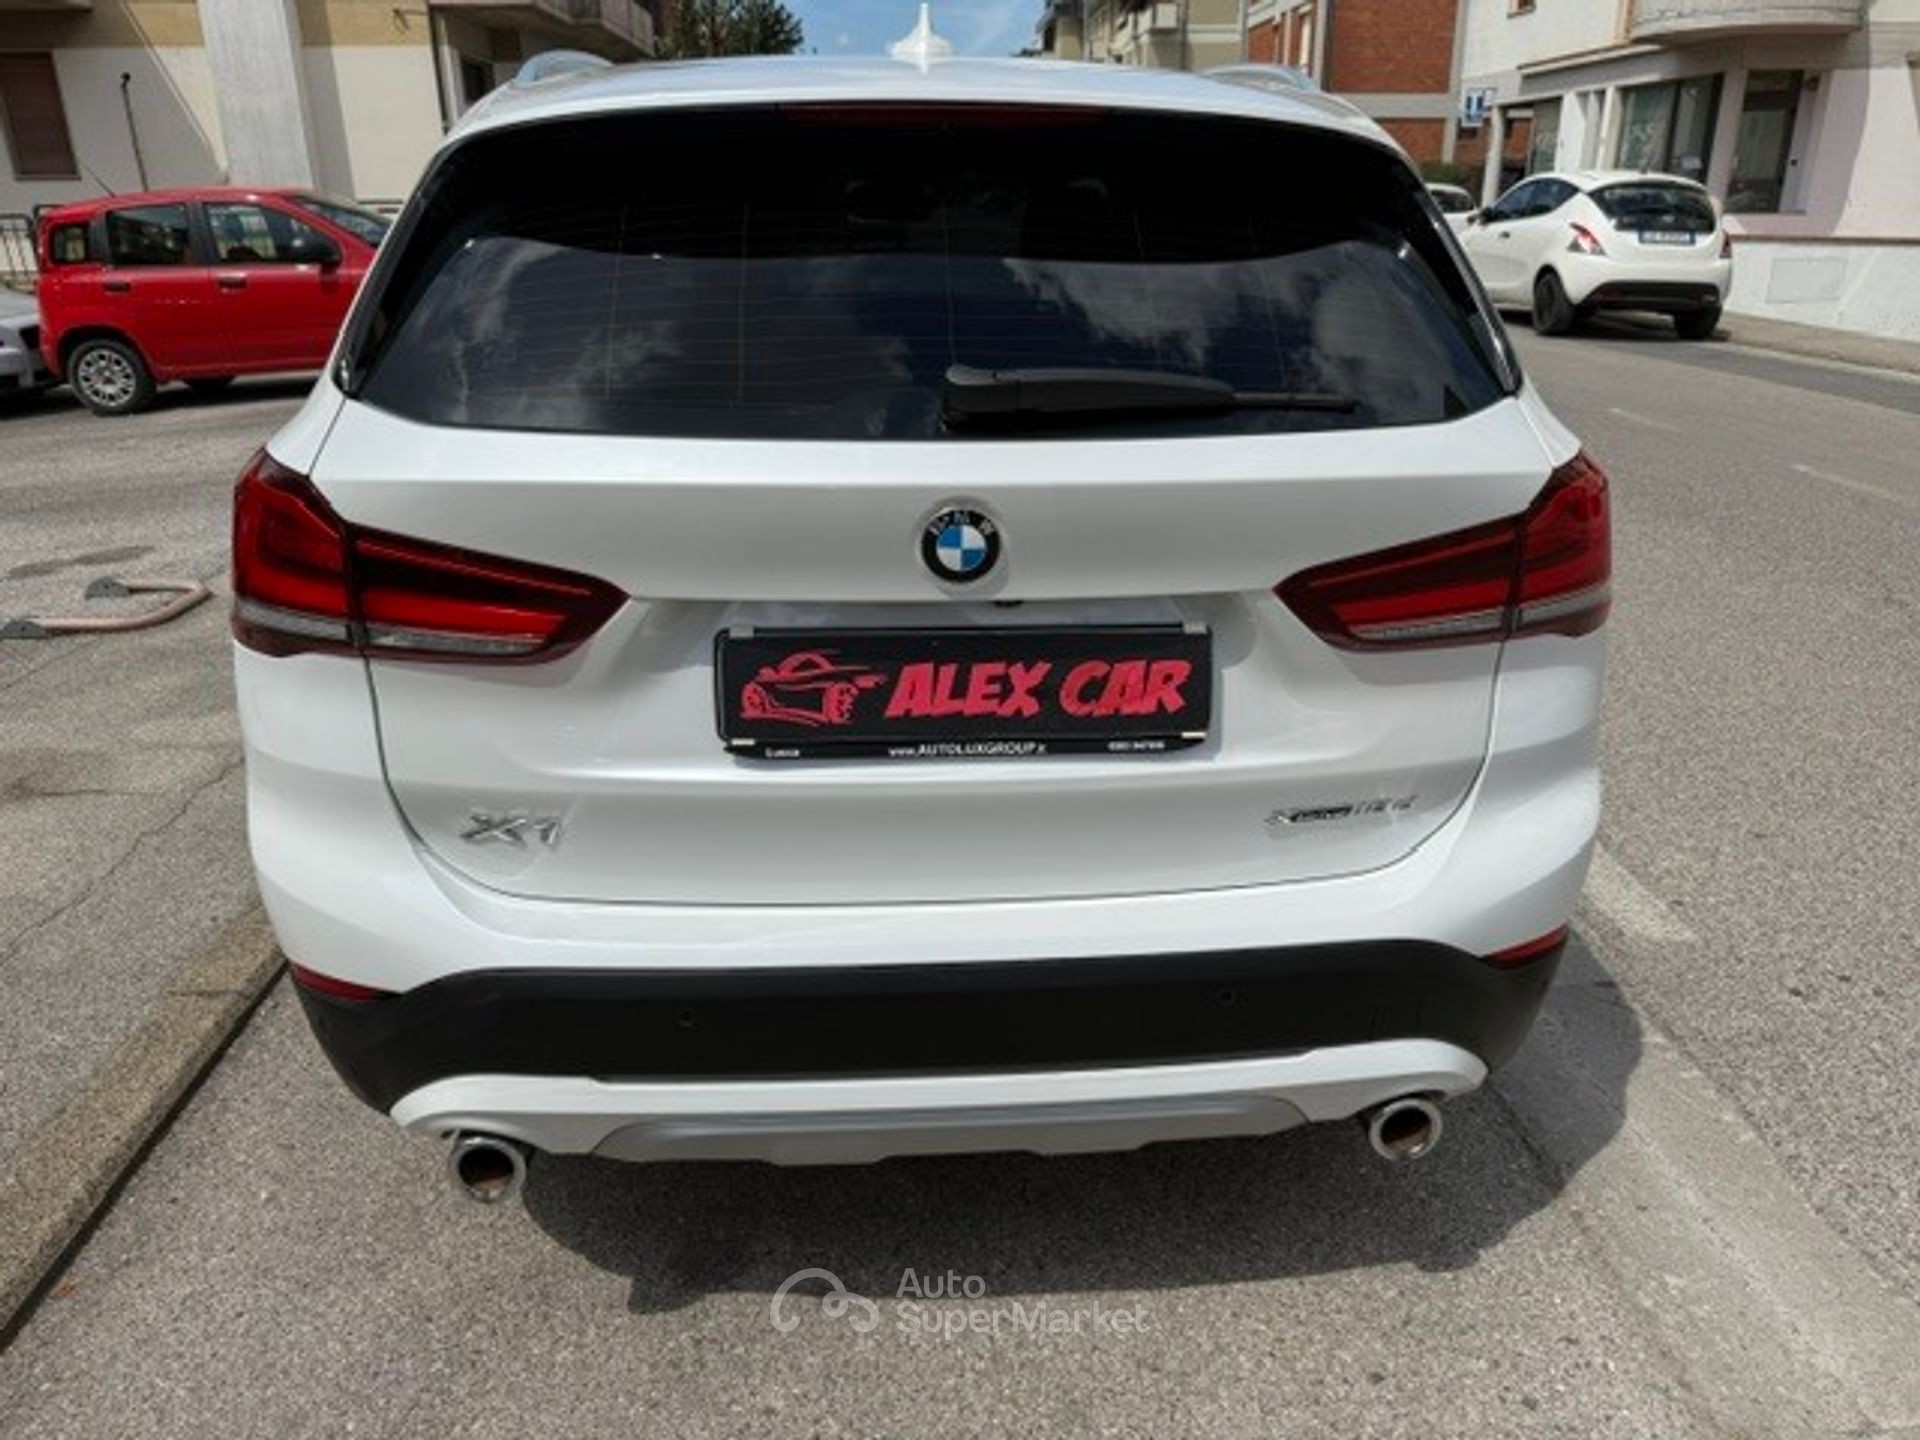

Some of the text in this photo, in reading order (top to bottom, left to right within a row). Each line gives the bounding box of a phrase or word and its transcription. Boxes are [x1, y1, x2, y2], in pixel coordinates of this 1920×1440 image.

[885, 660, 1192, 717] ALEX CAR
[460, 814, 560, 846] X1
